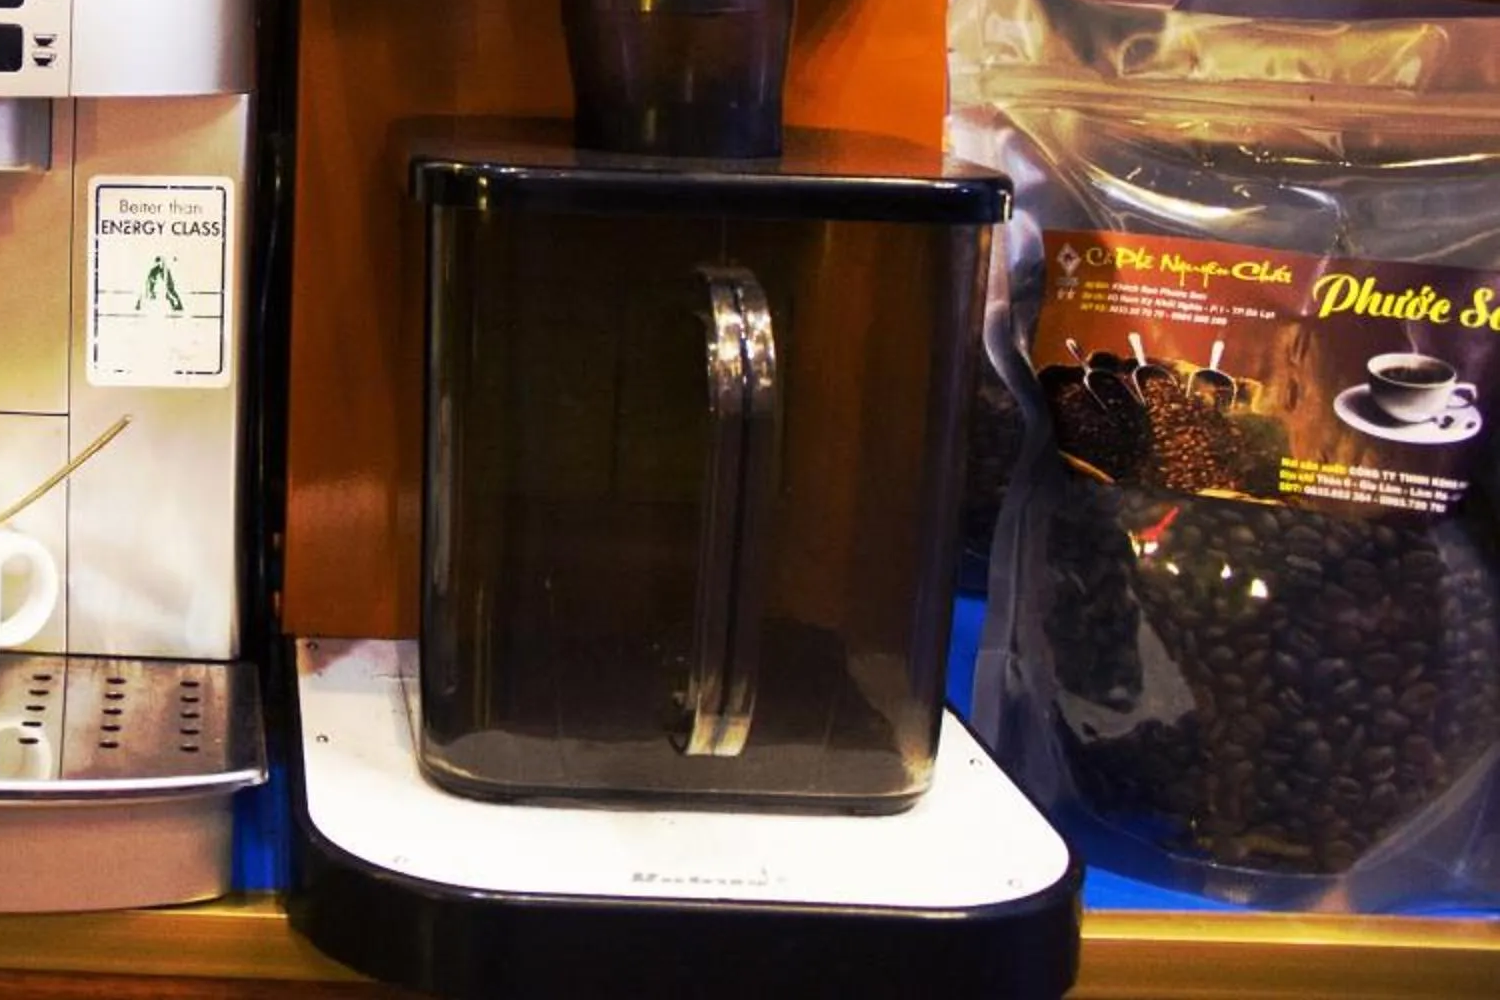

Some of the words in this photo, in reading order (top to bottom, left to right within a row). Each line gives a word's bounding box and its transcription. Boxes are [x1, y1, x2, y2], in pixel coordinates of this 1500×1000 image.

[169, 198, 203, 215] than
[101, 219, 165, 236] ENERGY
[171, 221, 222, 237] CLASS
